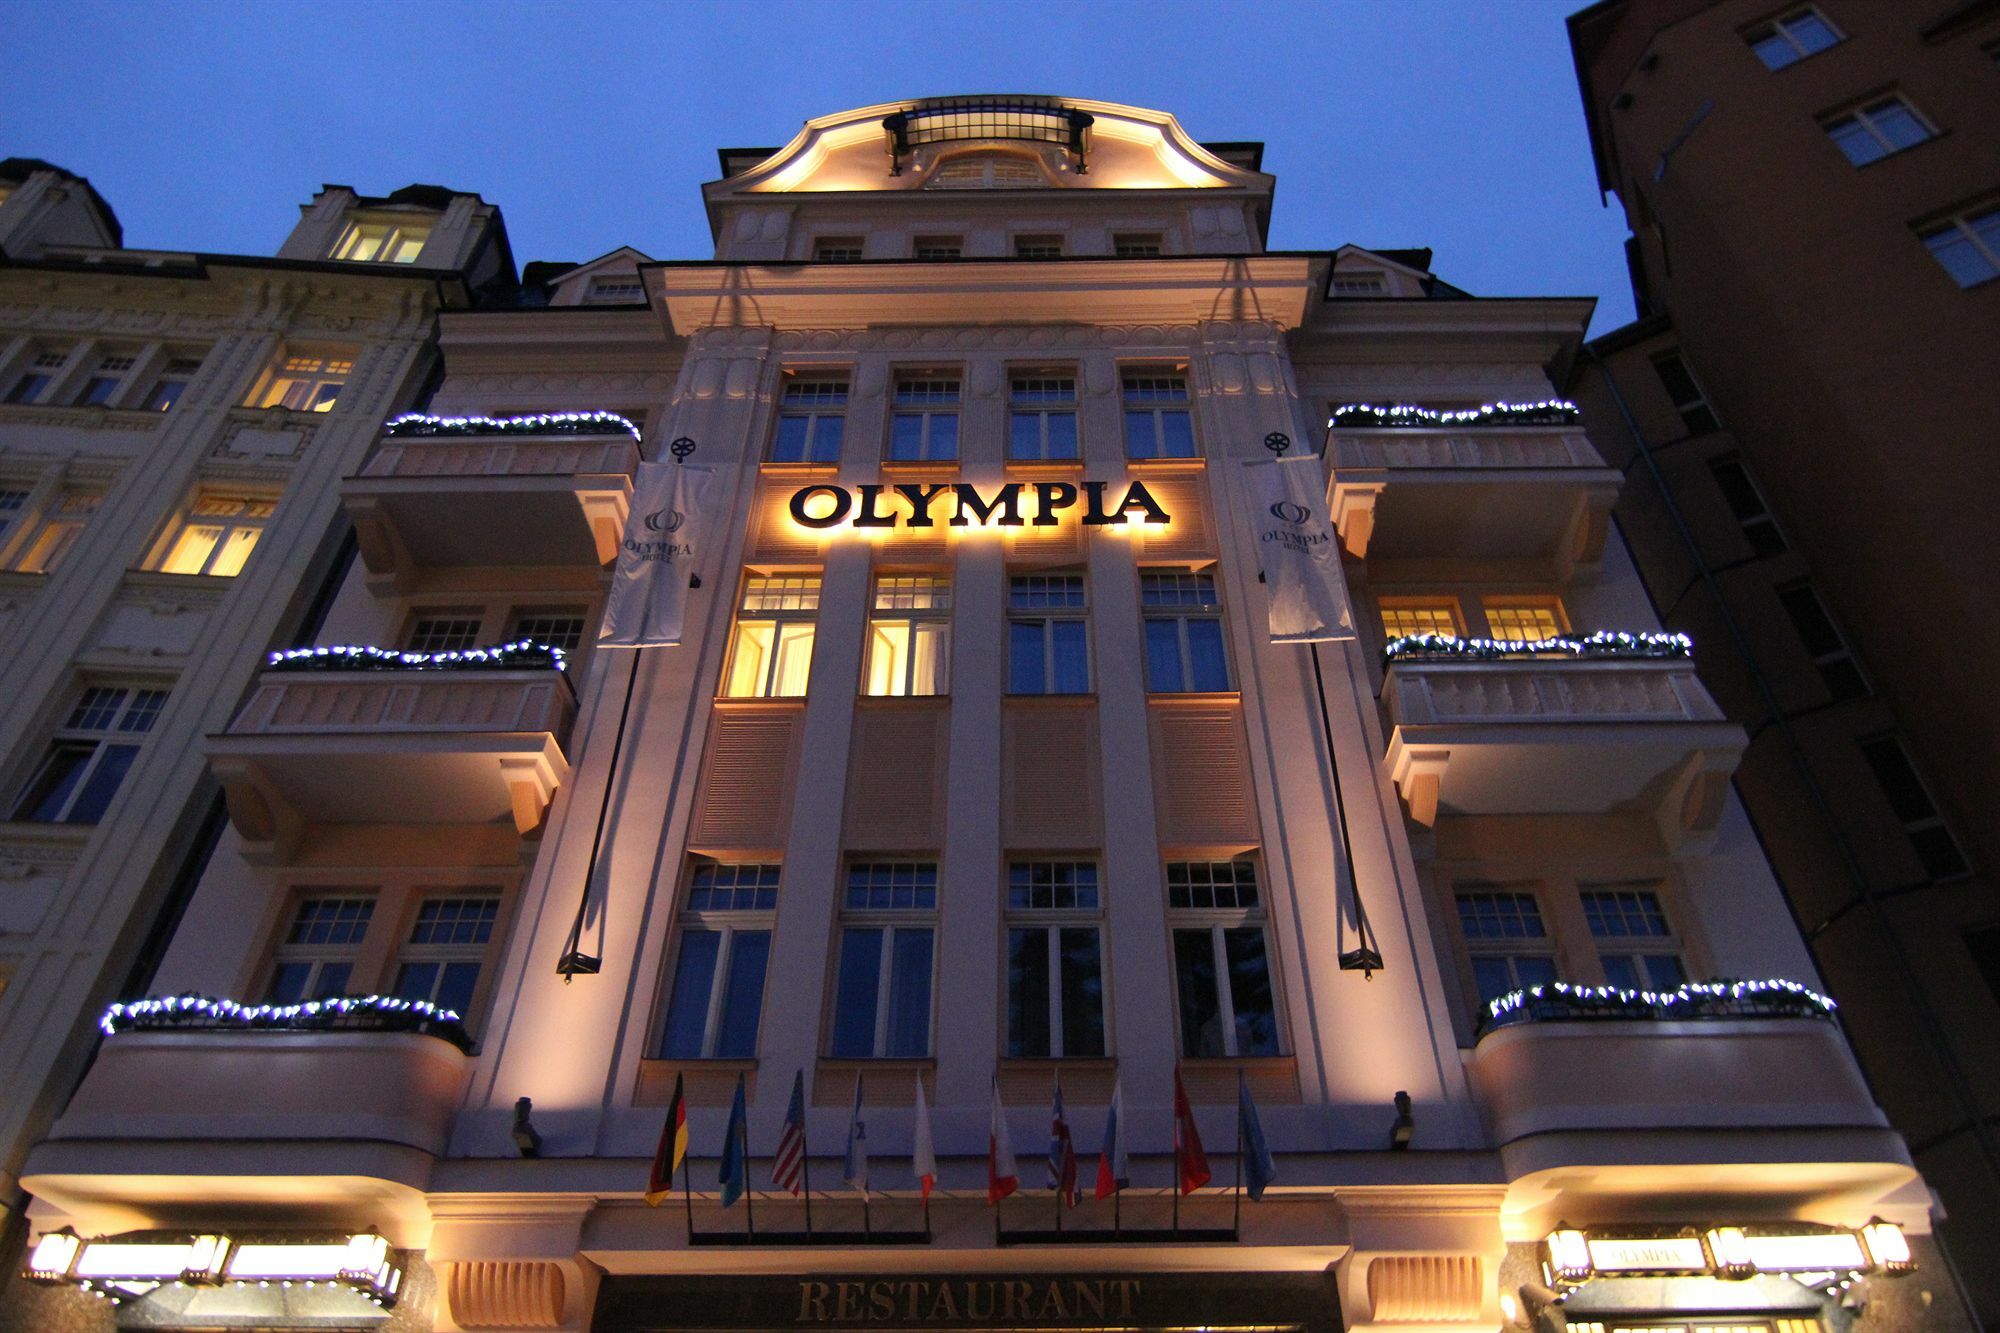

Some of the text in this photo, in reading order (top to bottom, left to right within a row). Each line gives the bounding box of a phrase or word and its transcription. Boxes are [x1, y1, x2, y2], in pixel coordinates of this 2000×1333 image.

[789, 480, 1171, 528] OLYMPIA
[624, 540, 692, 556] OLYMPIA
[1262, 531, 1329, 547] OLYMPIA
[796, 1279, 1141, 1321] RESTAURANT
